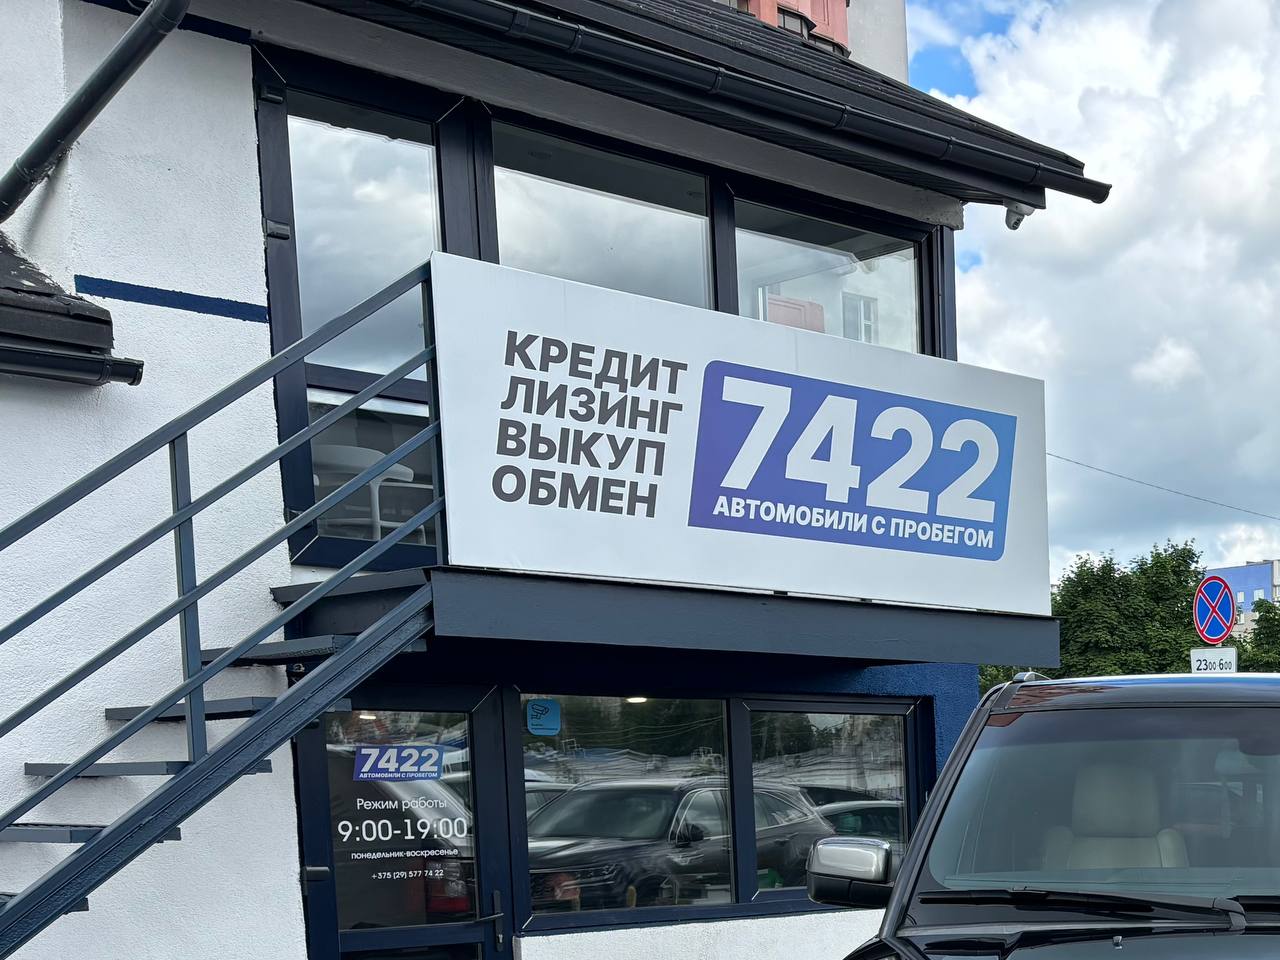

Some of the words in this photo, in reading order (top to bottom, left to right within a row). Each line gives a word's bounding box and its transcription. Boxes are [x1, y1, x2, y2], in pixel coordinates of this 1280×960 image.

[505, 330, 688, 394] КРЕДИТ
[500, 375, 683, 435] ЛИЗИНГ
[496, 418, 666, 476] ВЫКУП
[720, 375, 1000, 523] 7422
[492, 464, 658, 518] ОБМЕН
[712, 495, 867, 533] АВТОМОБИЛИ
[871, 516, 886, 535] С
[890, 518, 995, 549] ПРОБЕГОМ
[361, 748, 439, 772] 7422
[337, 818, 467, 842] 9:00-19:00
[356, 798, 398, 810] Режим
[402, 797, 447, 811] работы
[351, 848, 458, 860] понедельник-воскресенье
[372, 872, 391, 880] +375
[393, 871, 407, 879] (29)
